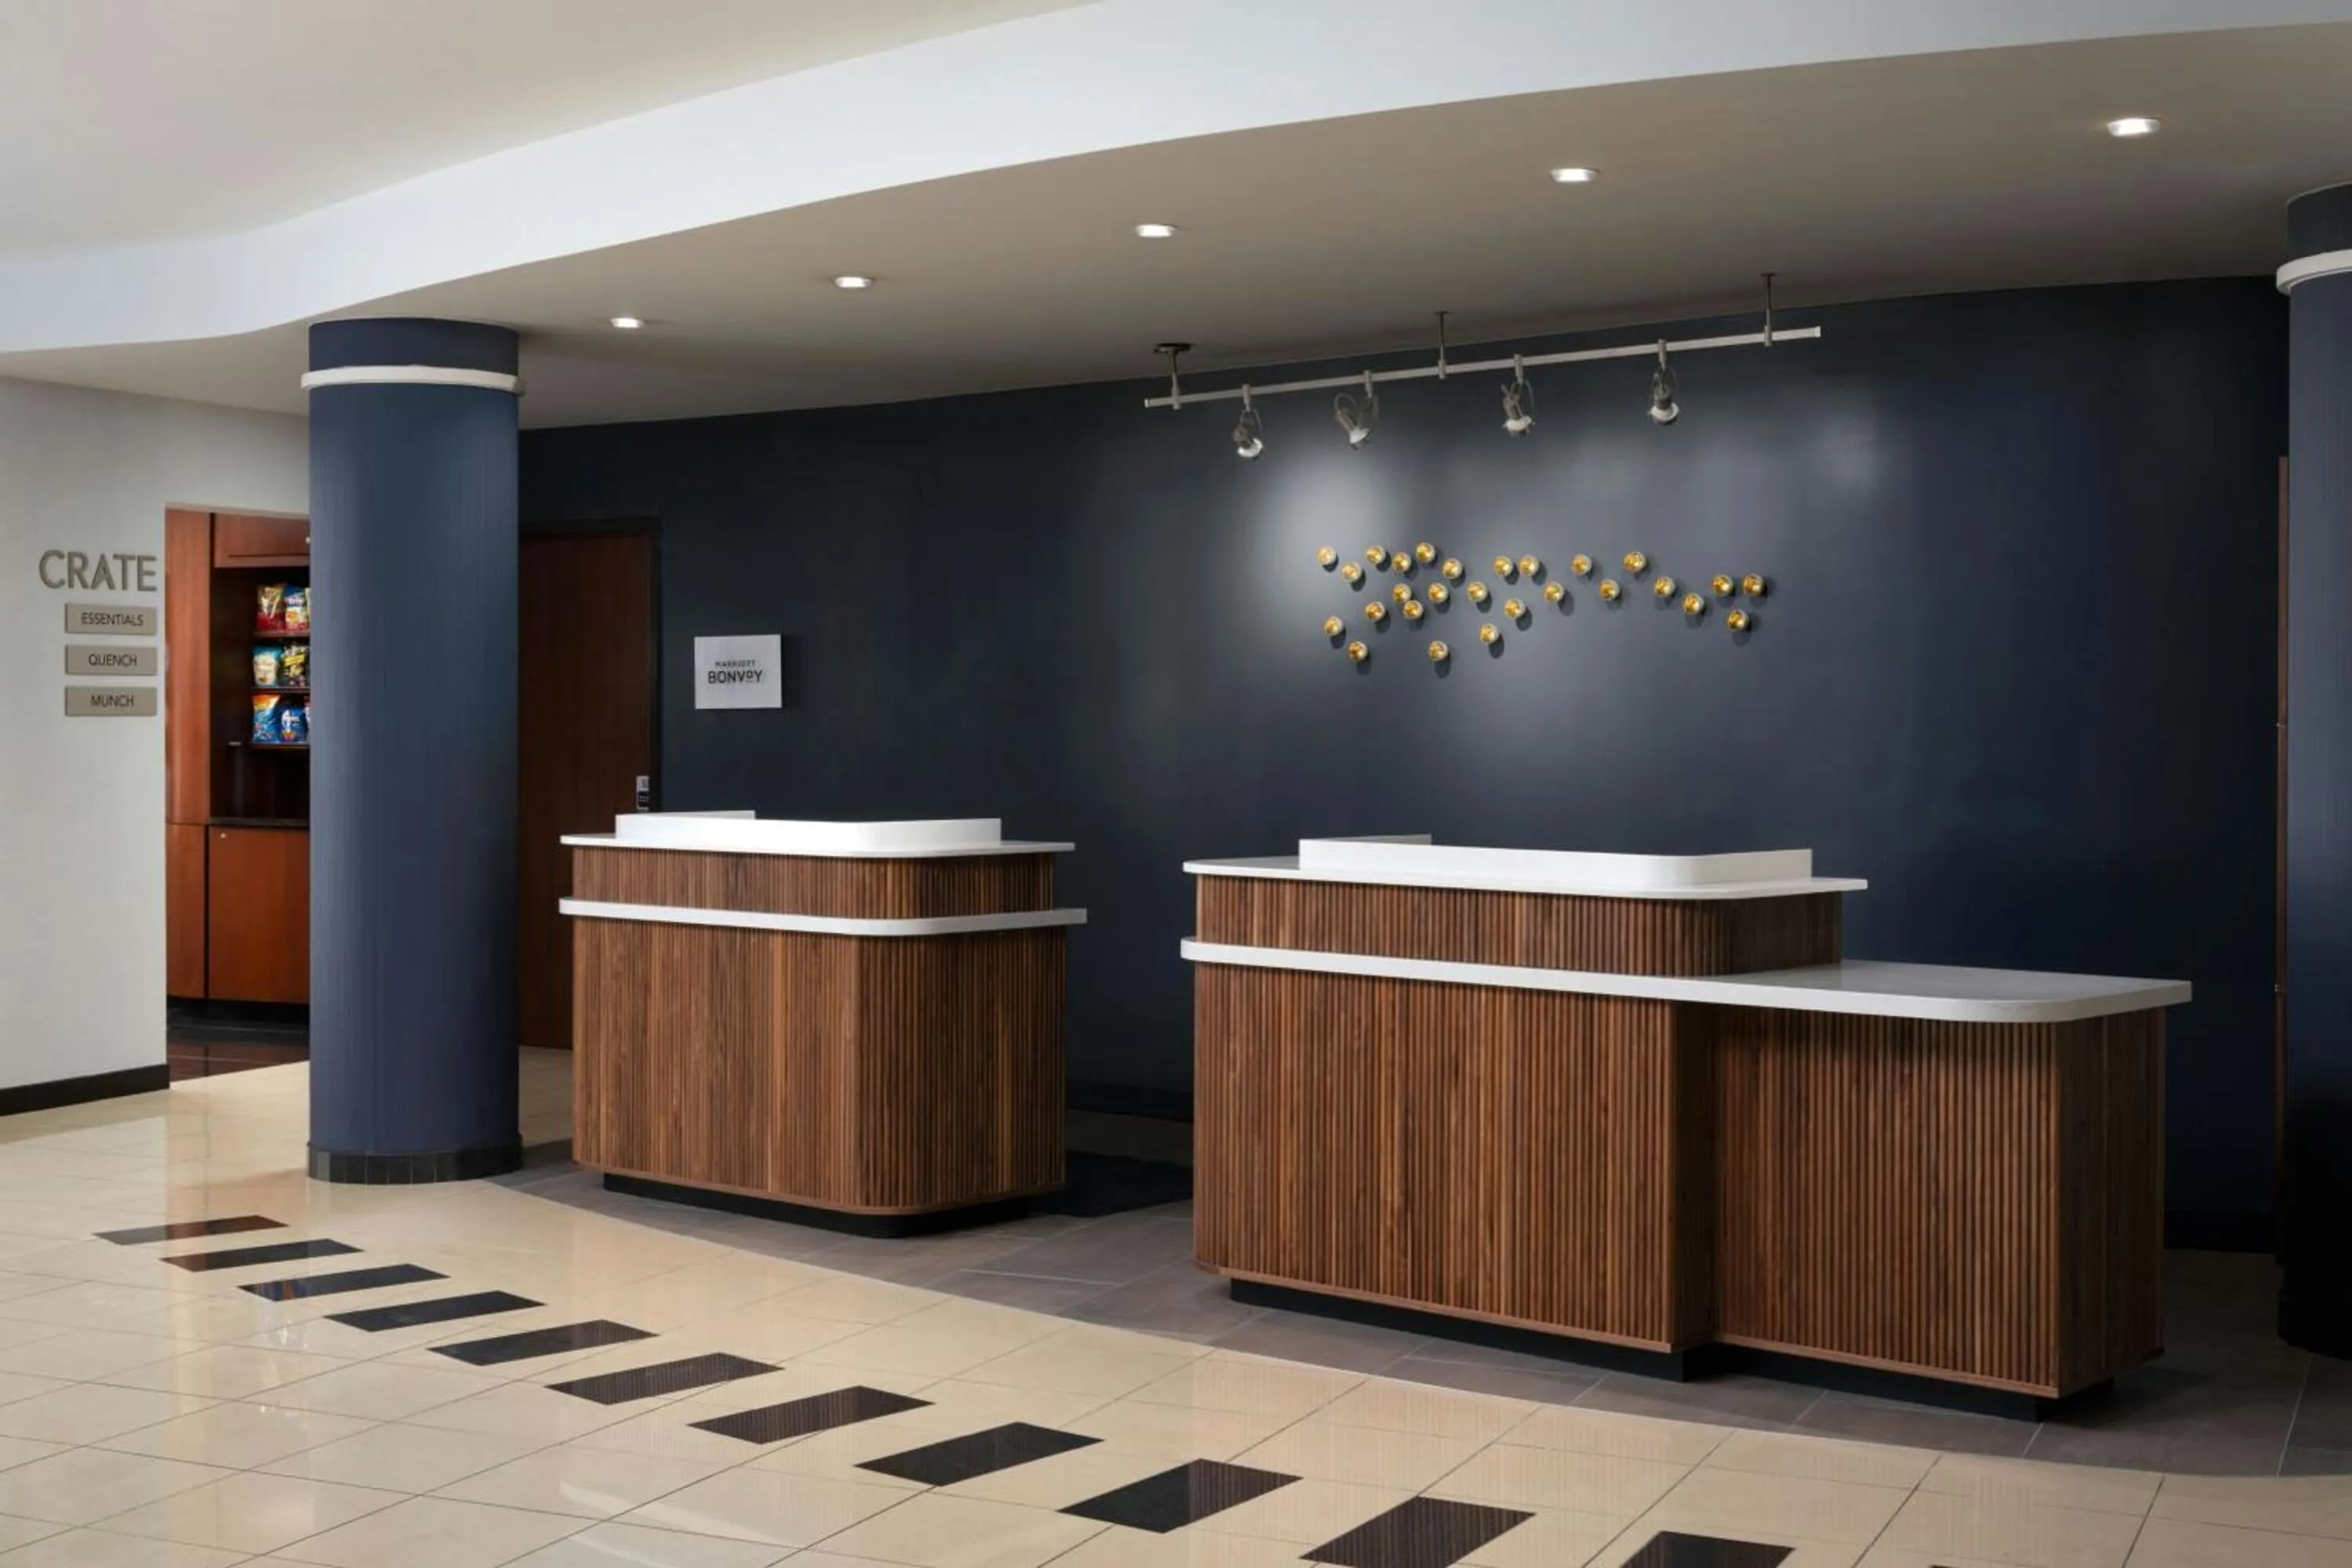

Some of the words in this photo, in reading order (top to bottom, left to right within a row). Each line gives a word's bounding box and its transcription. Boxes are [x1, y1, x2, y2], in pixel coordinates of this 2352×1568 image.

[39, 549, 158, 591] CRATE
[82, 612, 143, 626] ESSENTIALS
[89, 653, 137, 666] QUENCH
[708, 670, 763, 684] BONVOY
[90, 695, 134, 707] MUNCH
